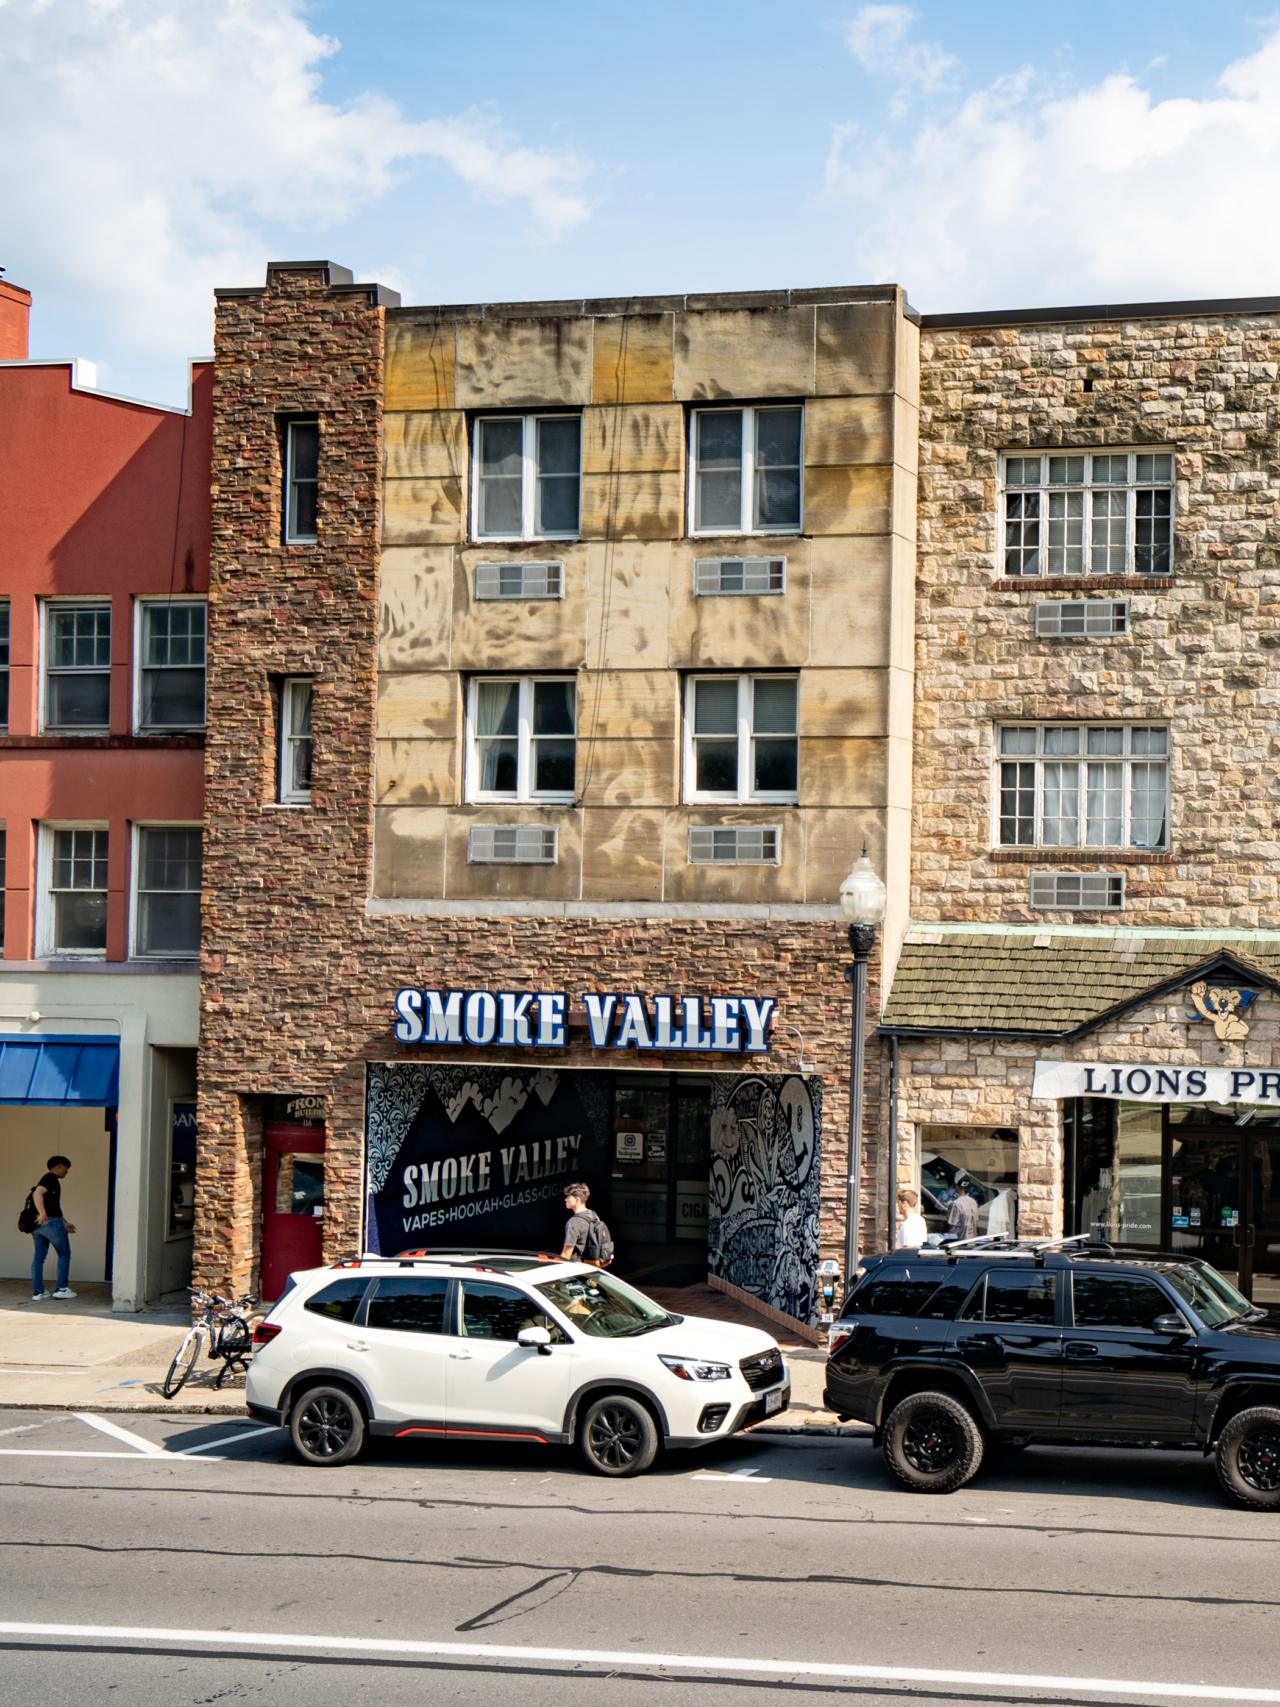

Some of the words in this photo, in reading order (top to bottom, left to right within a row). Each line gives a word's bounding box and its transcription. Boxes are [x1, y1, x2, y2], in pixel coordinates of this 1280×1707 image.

[394, 988, 567, 1047] SMOKE
[583, 994, 774, 1053] VALLEY
[1084, 1068, 1207, 1097] LIONS
[403, 1151, 492, 1209] SMOKE
[500, 1134, 582, 1187] VALLEY
